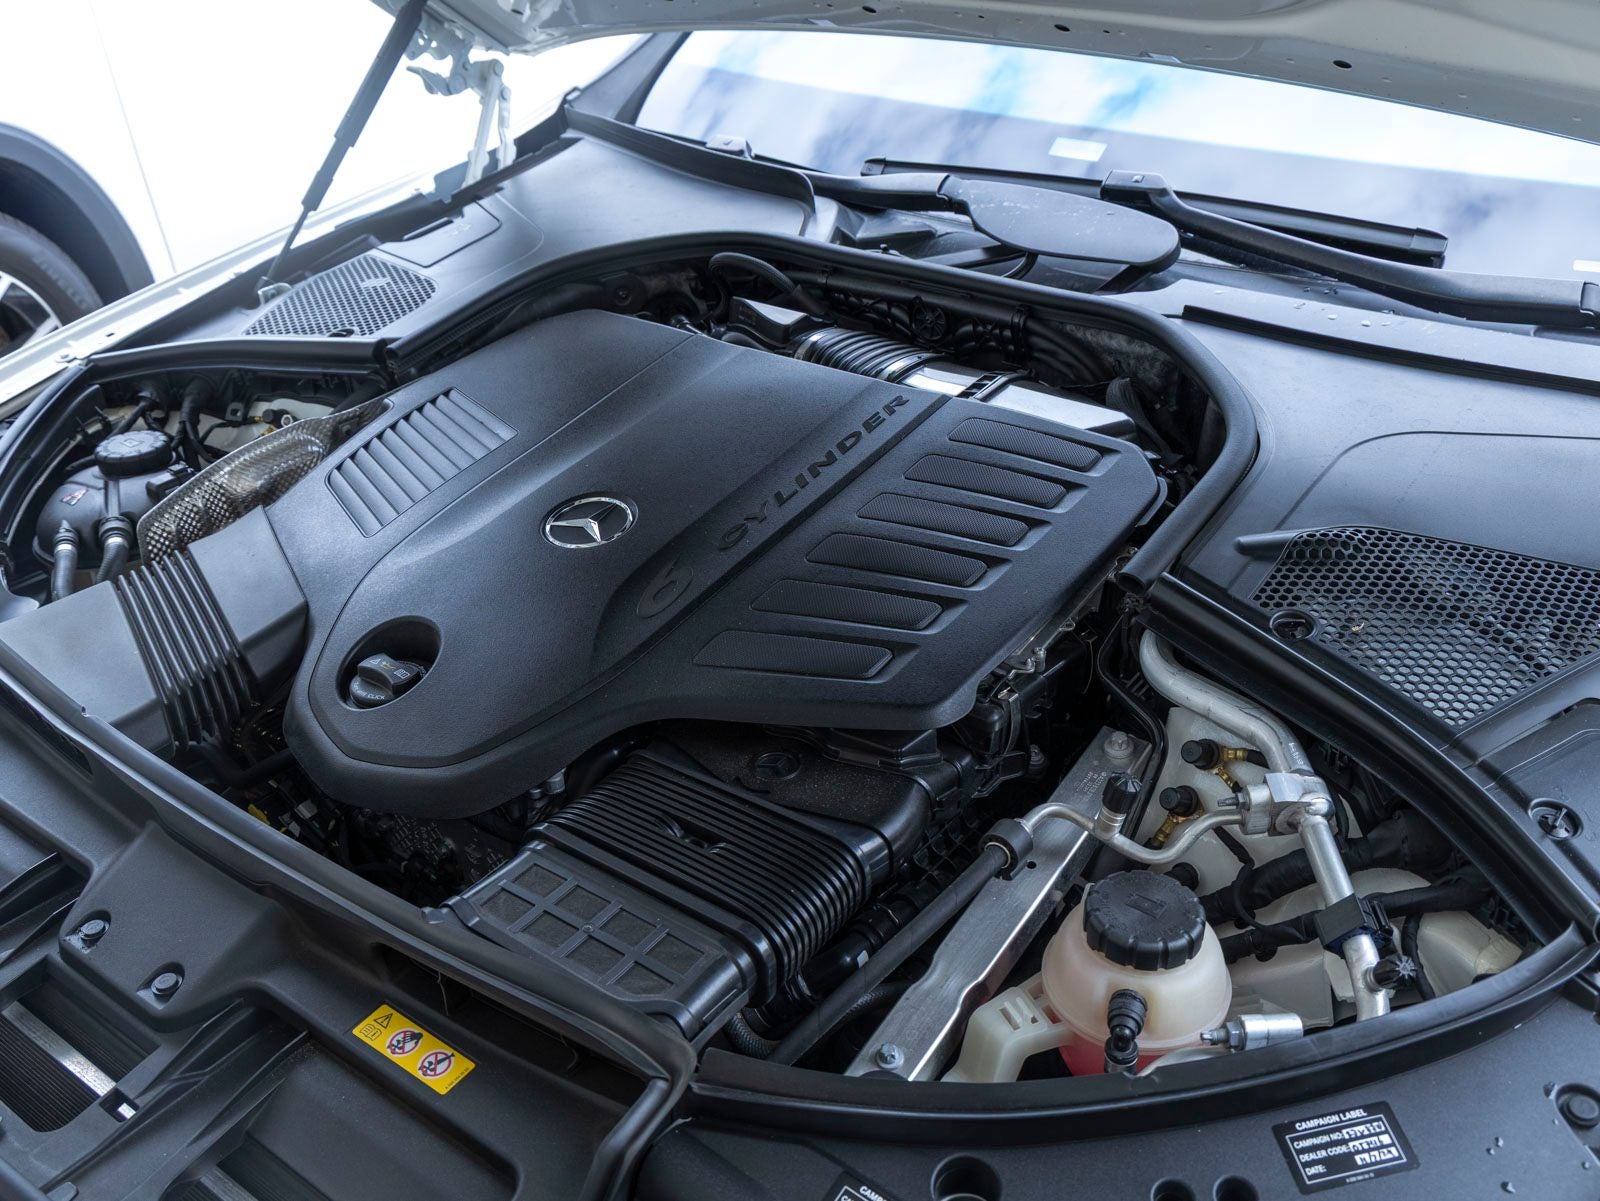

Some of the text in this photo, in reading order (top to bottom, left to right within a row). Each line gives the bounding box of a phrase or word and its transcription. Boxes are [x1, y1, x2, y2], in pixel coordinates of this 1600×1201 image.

[720, 395, 909, 550] CYLINDER
[1295, 1115, 1340, 1131] CAMPAIGN
[1341, 1108, 1368, 1121] LABEL
[1293, 1134, 1330, 1149] CAMPAIGN
[1299, 1149, 1328, 1162] DEALER
[1305, 1164, 1328, 1176] DATE:
